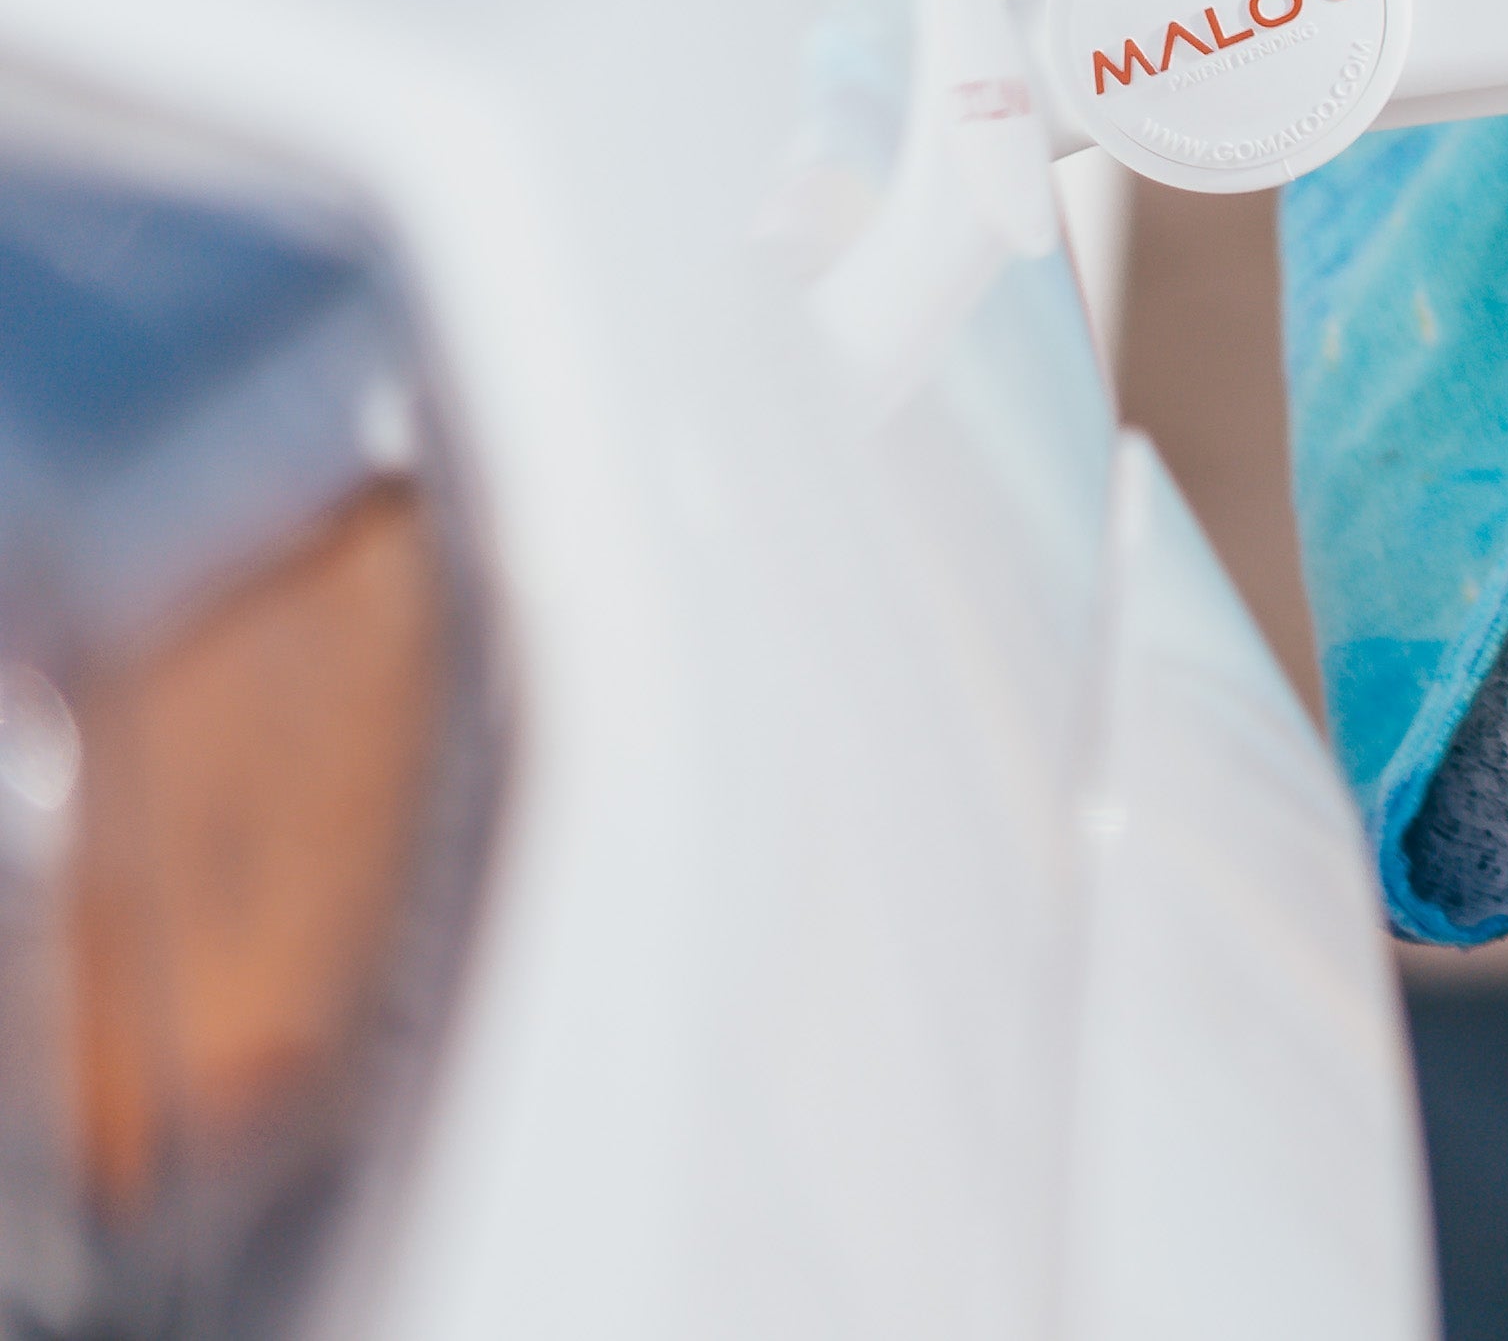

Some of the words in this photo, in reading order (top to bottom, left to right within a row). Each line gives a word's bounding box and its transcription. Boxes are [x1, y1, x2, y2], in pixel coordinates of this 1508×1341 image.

[1140, 38, 1373, 161] WWW.GOMALOO.COM
[1168, 56, 1233, 93] PATENT
[1235, 21, 1319, 67] PENDING
